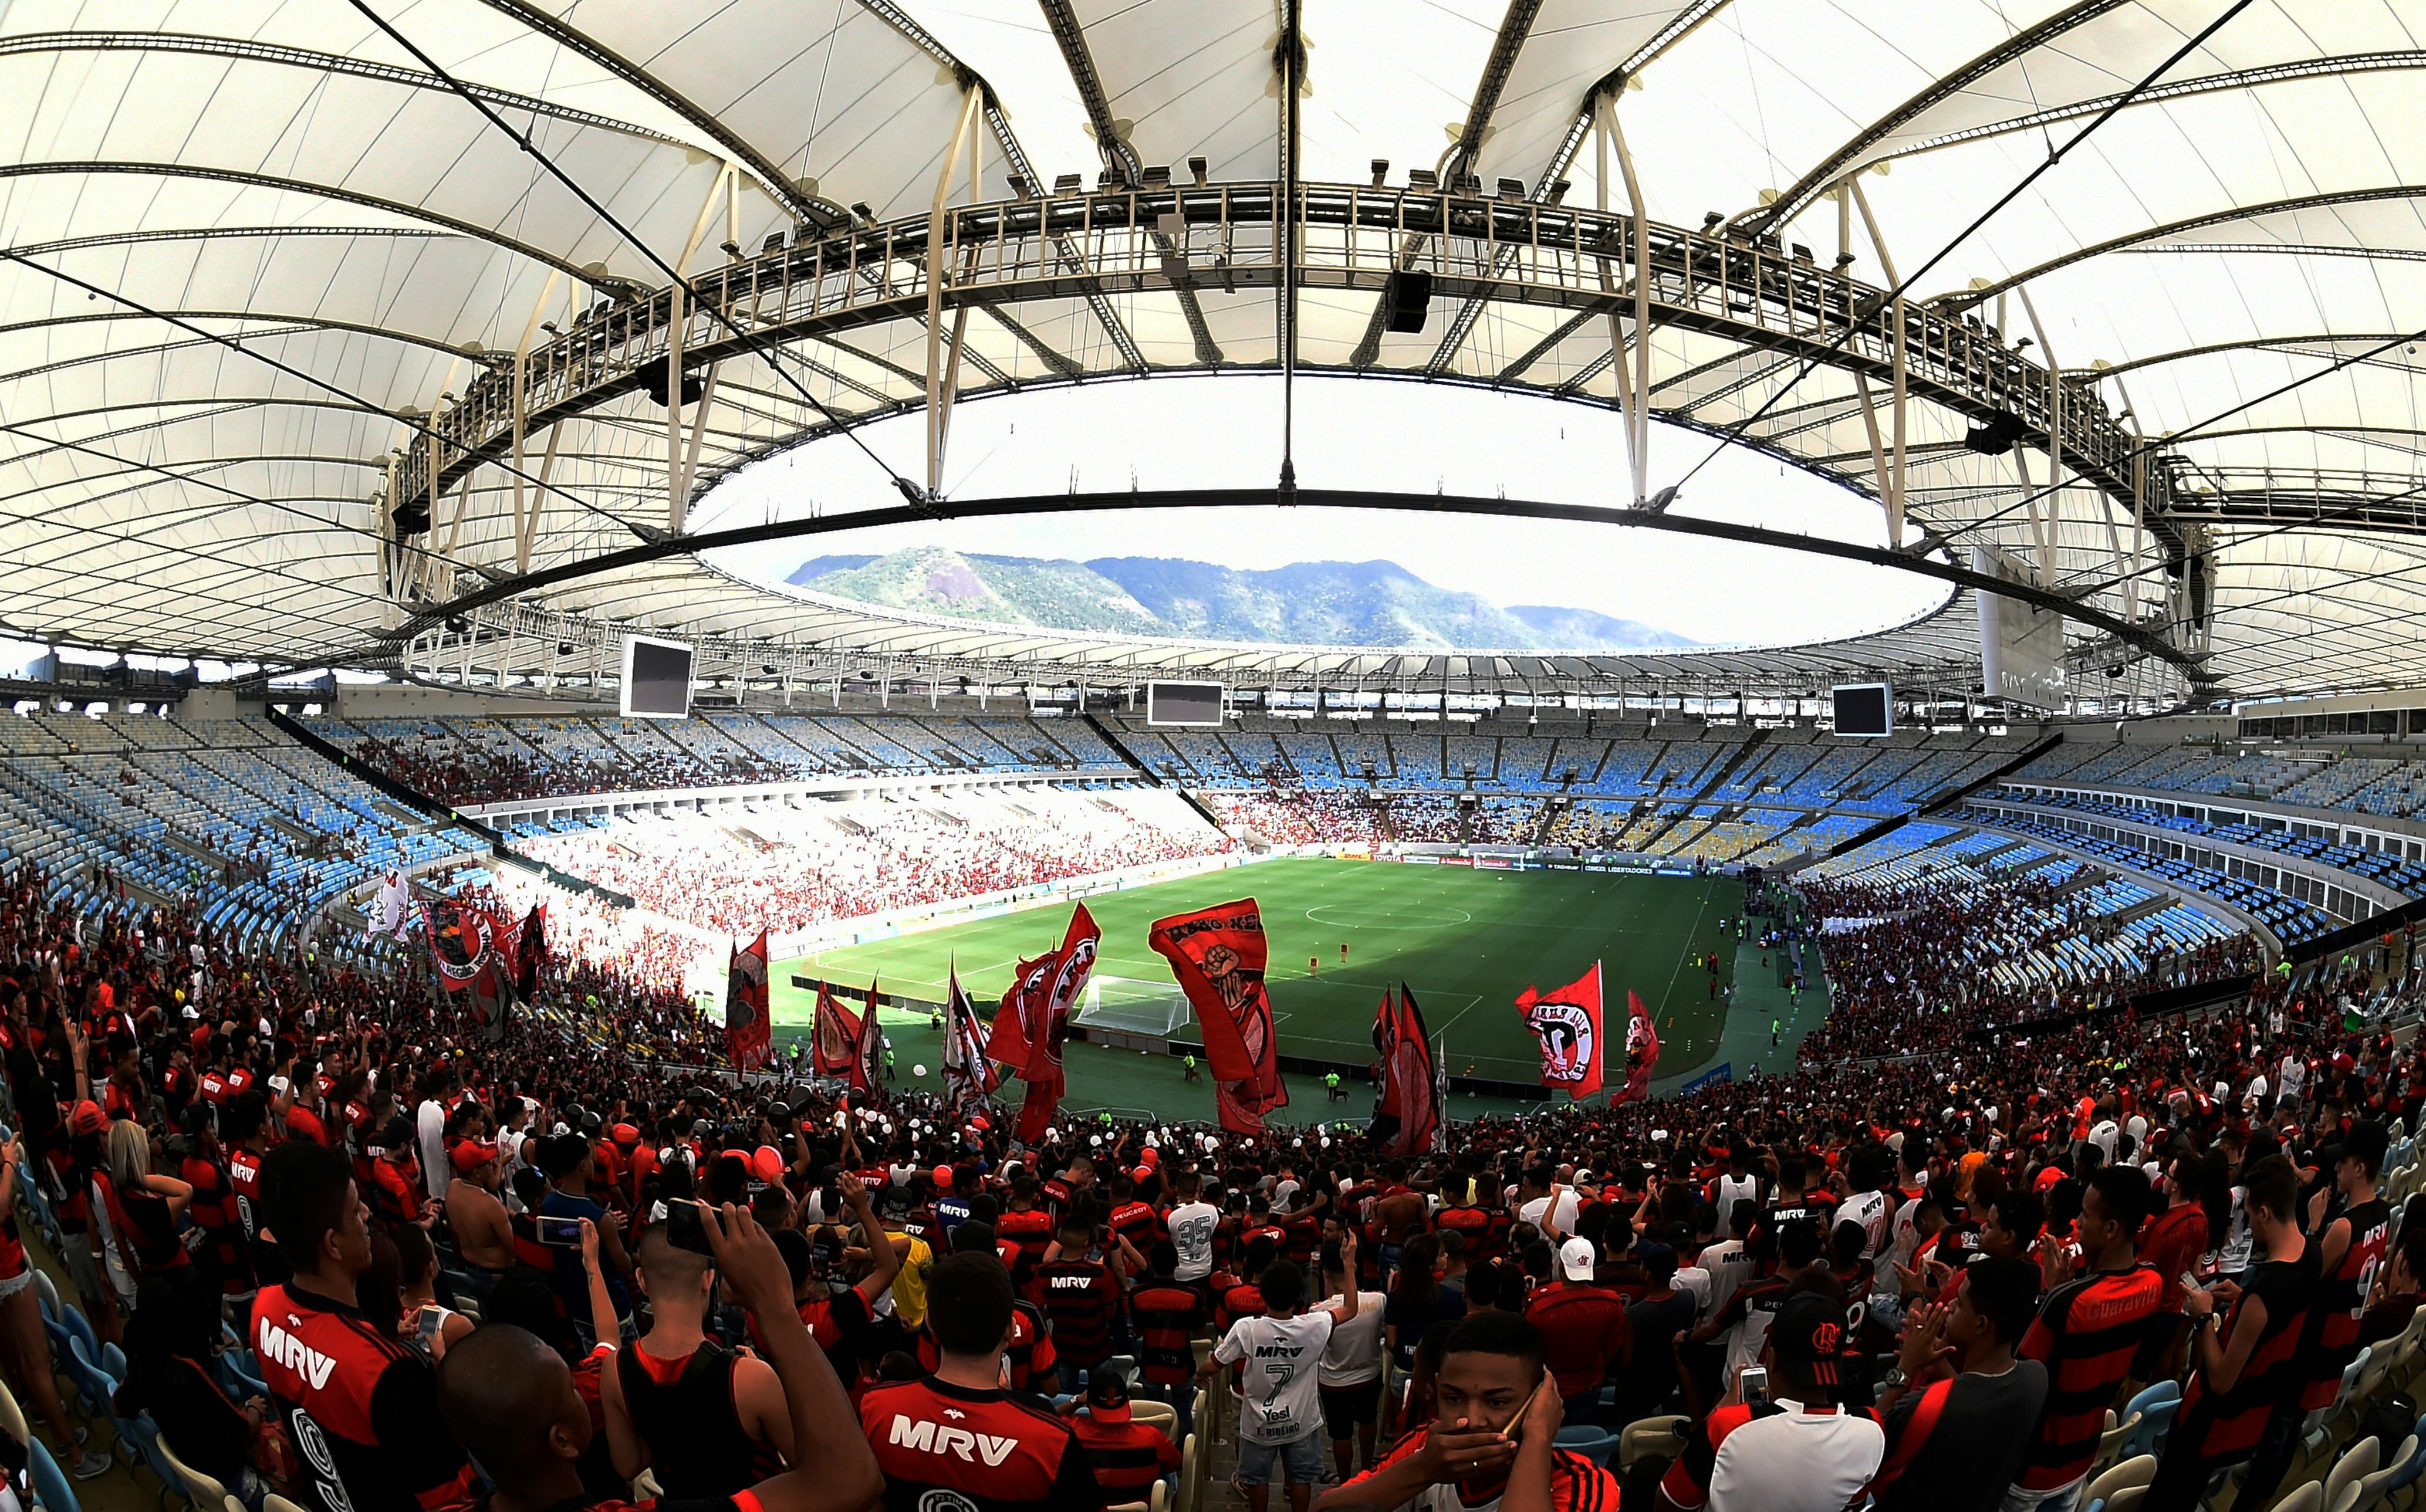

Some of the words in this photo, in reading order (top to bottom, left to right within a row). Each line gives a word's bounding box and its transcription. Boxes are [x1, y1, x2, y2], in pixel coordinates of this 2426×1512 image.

[367, 1145, 386, 1156] MR
[231, 1162, 255, 1183] MRV
[889, 1199, 907, 1210] THUG
[939, 1203, 970, 1218] MRV
[1861, 1198, 1882, 1219] MRV
[1113, 1206, 1147, 1222] PEUGEOT
[1775, 1209, 1806, 1221] MRV
[905, 1224, 925, 1234] RV
[1178, 1215, 1212, 1250] 35
[2363, 1221, 2388, 1248] MRV
[1051, 1276, 1092, 1289] MRV
[2350, 1252, 2377, 1320] 9
[1232, 1294, 1266, 1305] Guara
[2086, 1286, 2158, 1321] Guaravita
[1846, 1300, 1866, 1344] 9
[259, 1316, 337, 1391] MRV
[1255, 1346, 1305, 1358] MRV
[1263, 1364, 1295, 1408] 7
[1266, 1422, 1300, 1437] RIBEIRO
[889, 1413, 1018, 1467] MRV
